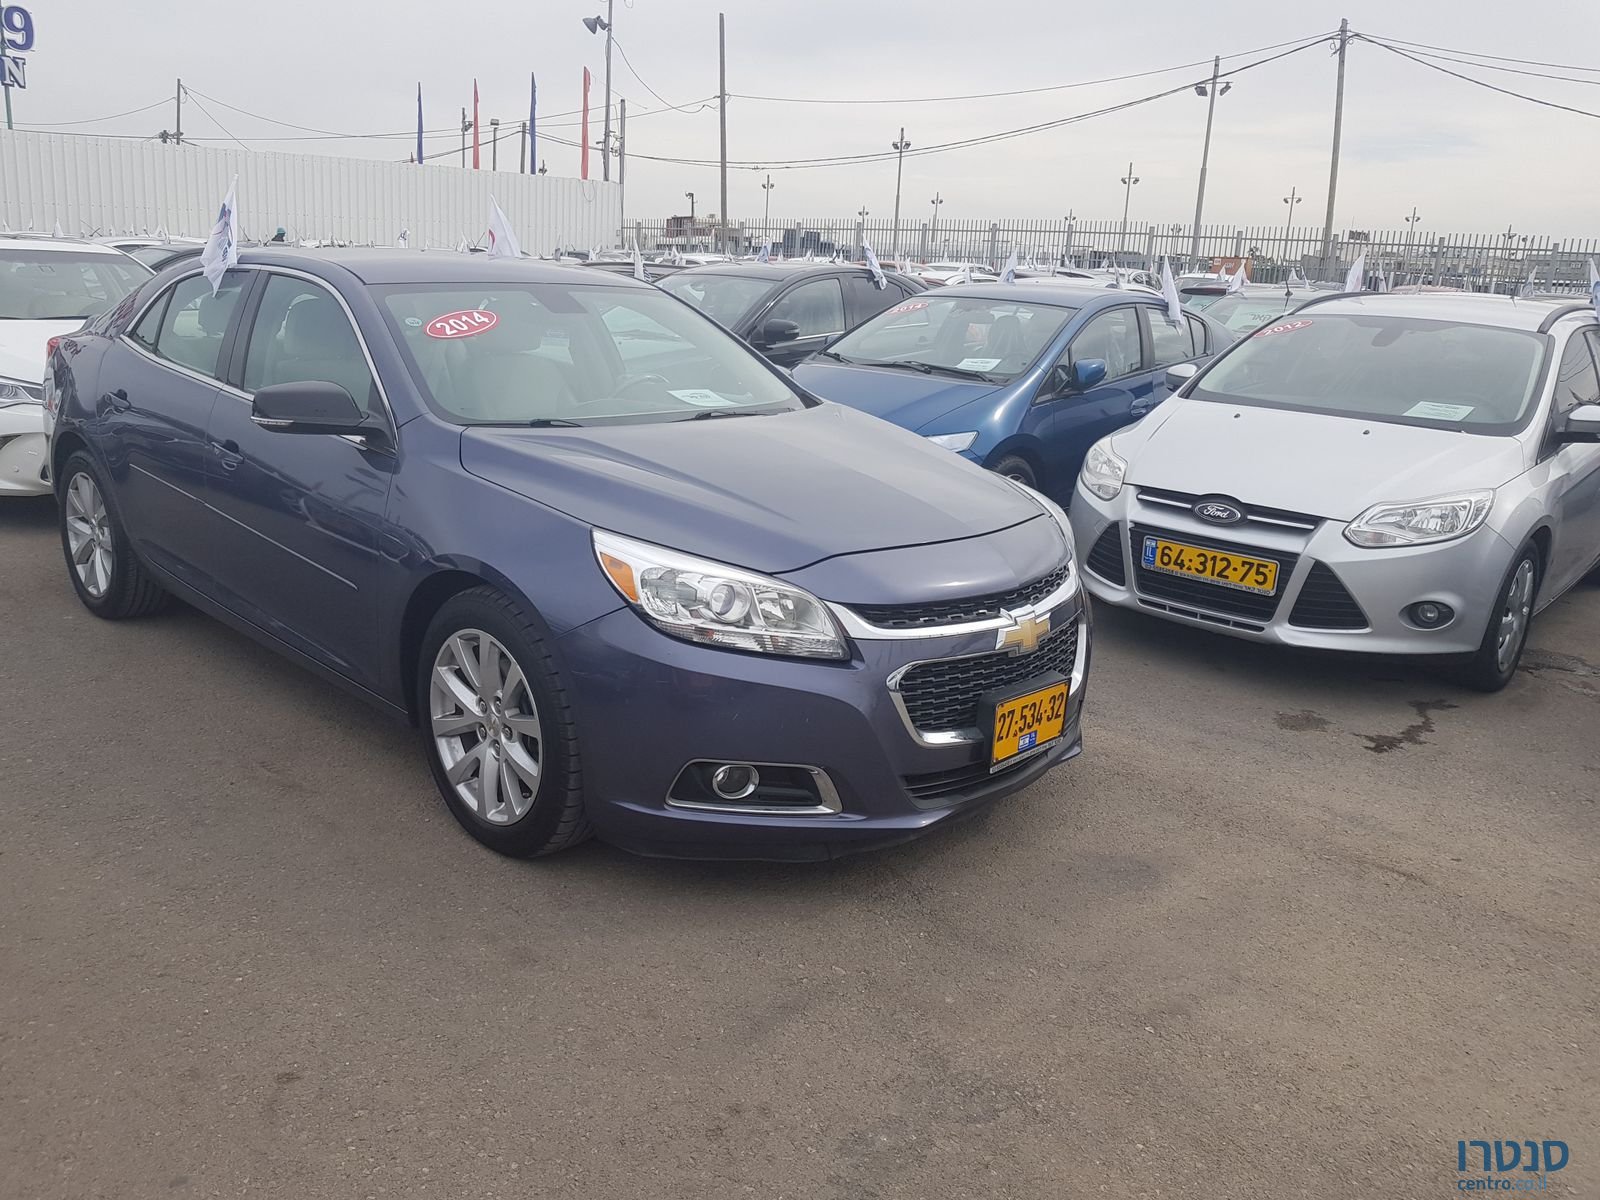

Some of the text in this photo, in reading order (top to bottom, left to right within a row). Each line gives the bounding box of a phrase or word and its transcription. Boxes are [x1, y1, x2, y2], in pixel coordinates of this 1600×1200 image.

[3, 6, 34, 51] 9
[435, 311, 490, 335] 2014
[1263, 321, 1302, 336] 2012
[1203, 504, 1230, 518] Ford
